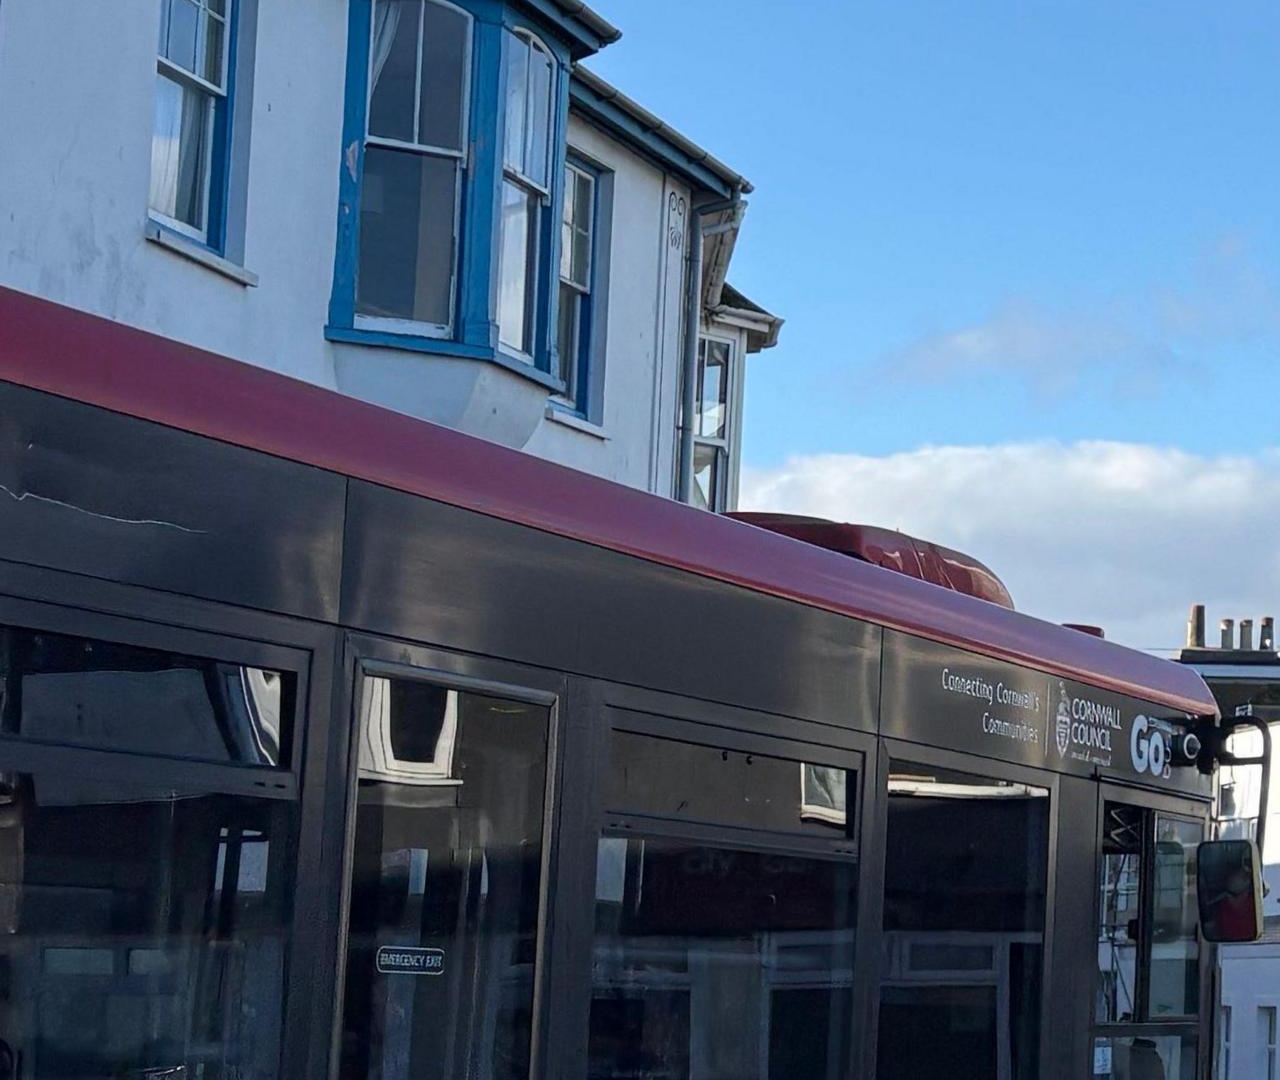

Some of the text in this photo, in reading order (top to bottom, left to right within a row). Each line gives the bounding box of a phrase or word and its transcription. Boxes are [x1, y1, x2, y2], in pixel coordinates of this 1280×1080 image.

[942, 668, 1039, 712] Connecting Cornwall's
[982, 712, 1038, 744] Communities
[1072, 698, 1122, 730] CORNWALL
[1071, 722, 1112, 751] COUNCIL
